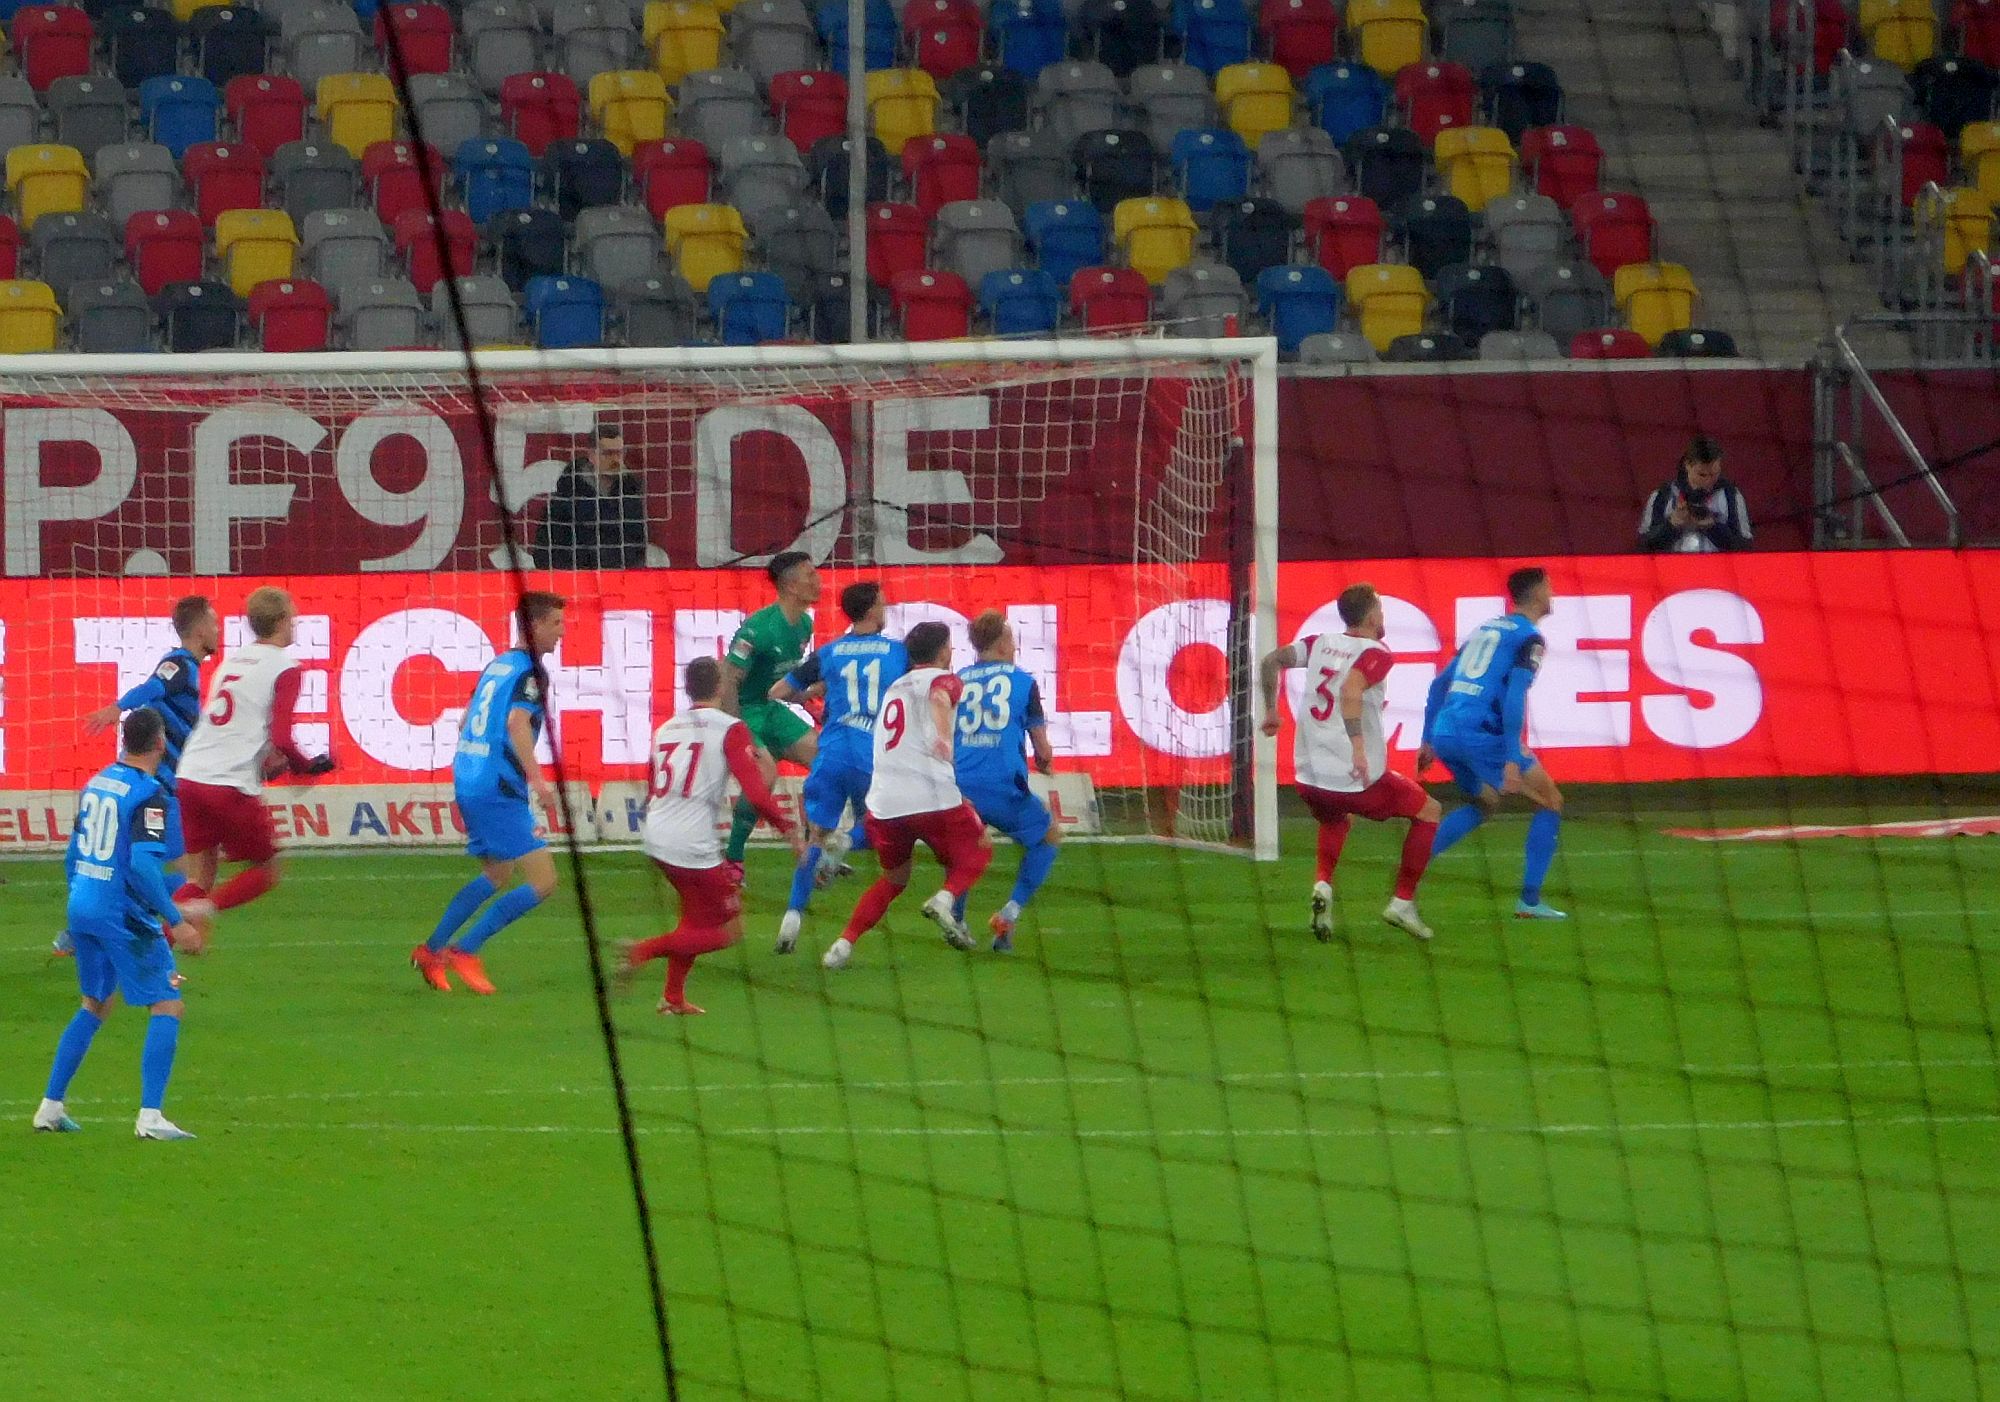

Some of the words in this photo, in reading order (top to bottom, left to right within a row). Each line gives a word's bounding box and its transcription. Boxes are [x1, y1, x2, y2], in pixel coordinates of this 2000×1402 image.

[209, 675, 242, 726] 5
[470, 679, 497, 737] 3
[840, 658, 880, 714] 11
[958, 674, 1012, 734] 33
[1310, 666, 1340, 721] 3
[883, 697, 905, 752] 9
[654, 742, 705, 799] 31
[77, 792, 119, 861] 30
